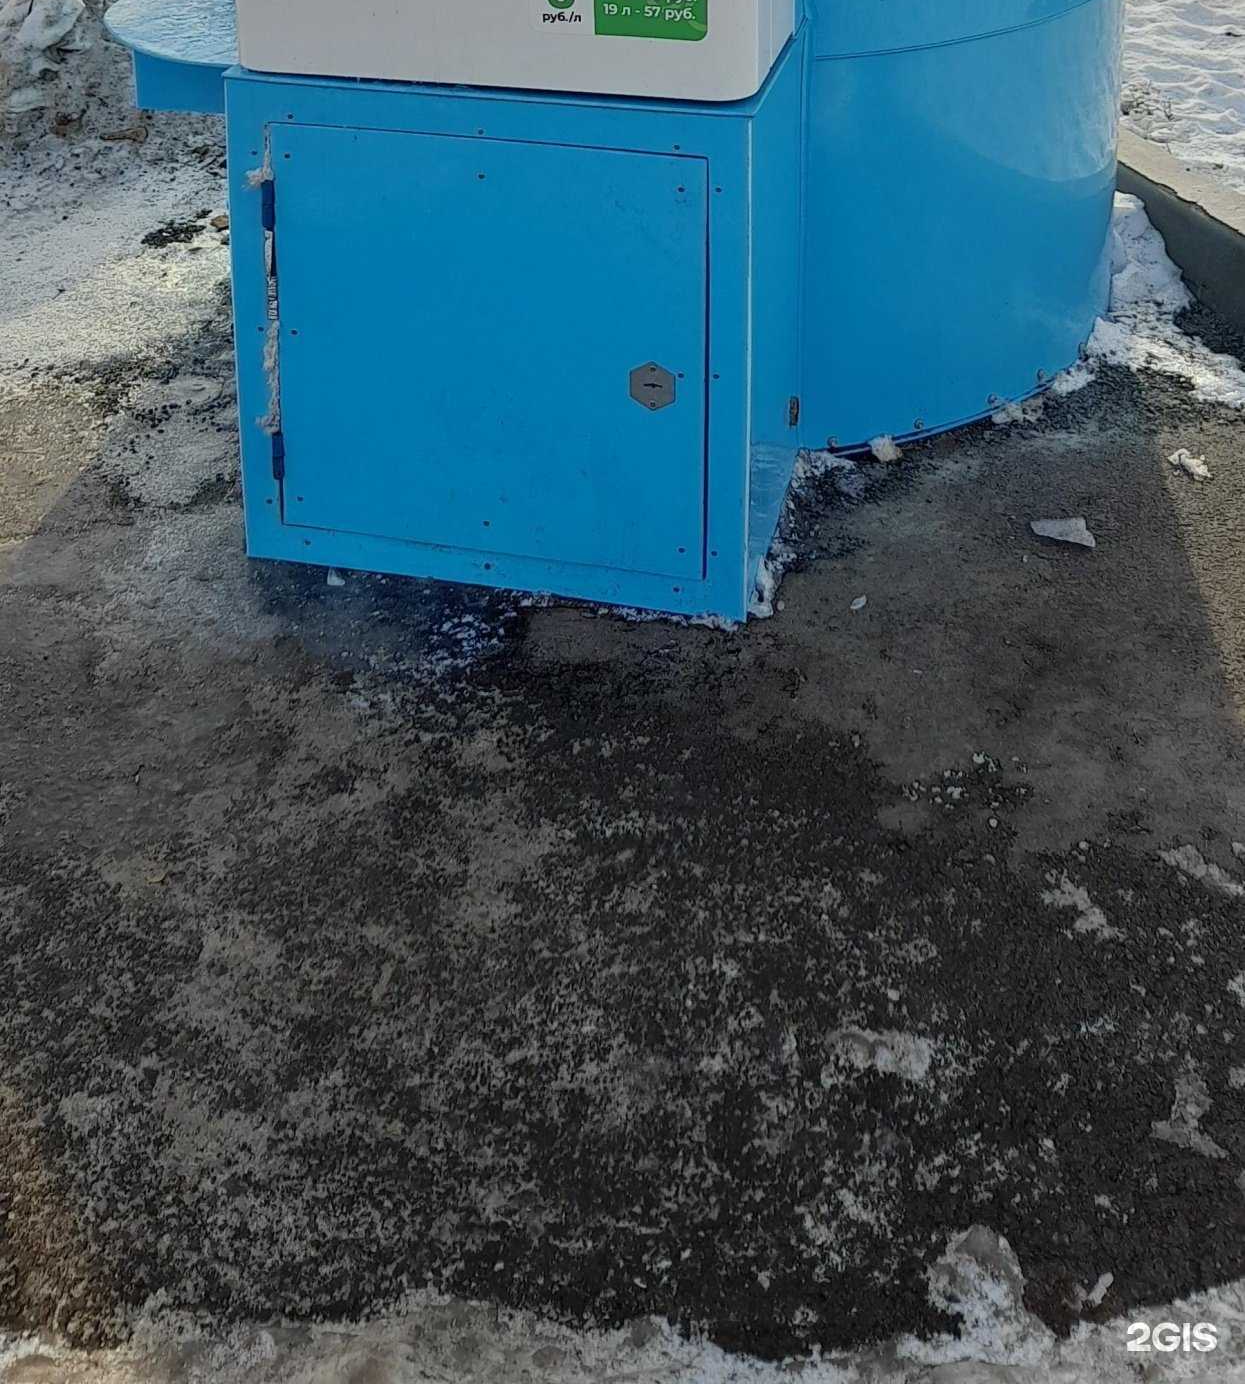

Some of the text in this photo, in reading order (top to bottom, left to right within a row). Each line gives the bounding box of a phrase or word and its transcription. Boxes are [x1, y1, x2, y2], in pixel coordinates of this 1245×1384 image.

[542, 11, 582, 23] руб./л
[603, 3, 618, 15] 19
[621, 6, 631, 16] л
[644, 6, 661, 17] 57
[665, 7, 696, 21] руб.
